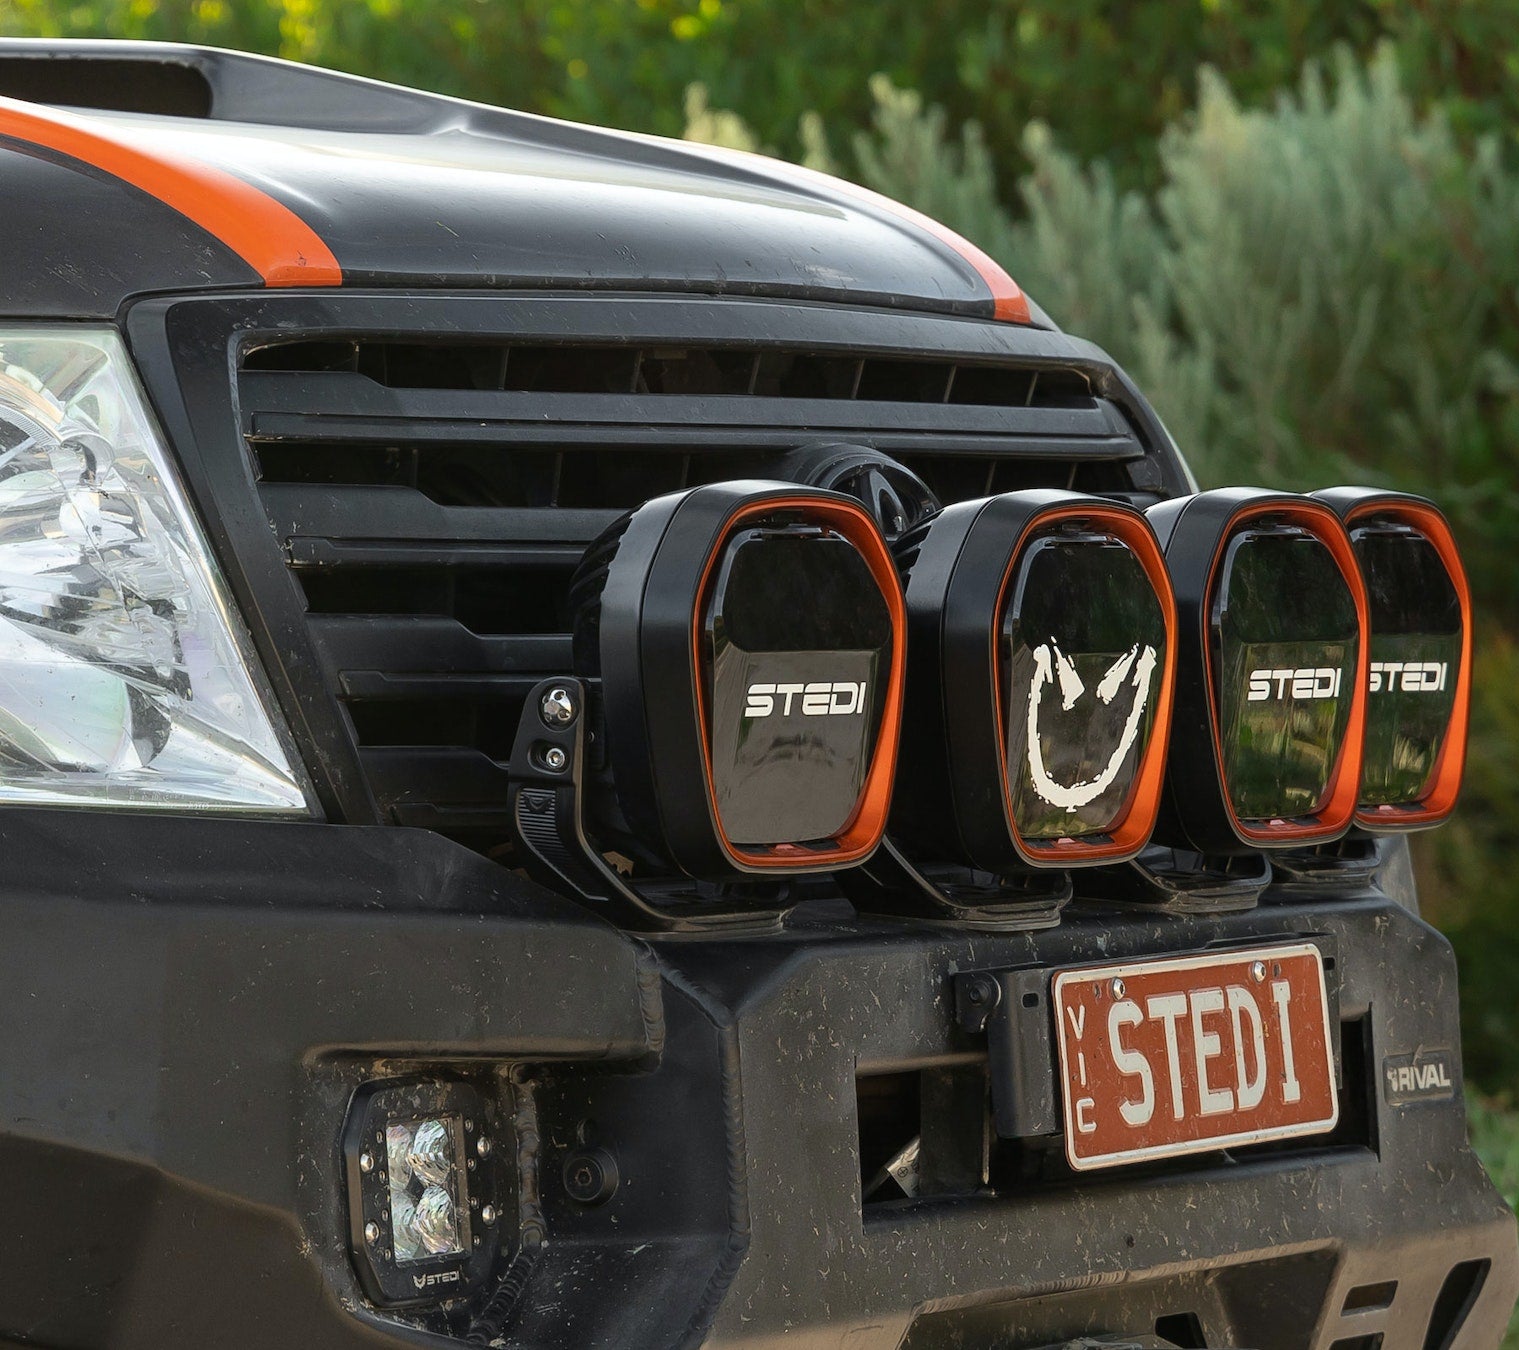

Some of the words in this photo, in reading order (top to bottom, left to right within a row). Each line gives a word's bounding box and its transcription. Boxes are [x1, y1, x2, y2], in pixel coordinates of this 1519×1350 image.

[1247, 667, 1342, 701] STEDI
[1368, 662, 1448, 692] STEDI
[744, 681, 867, 718] STEDI
[1066, 1004, 1097, 1133] VIC
[1107, 980, 1301, 1126] STEDI
[1397, 1063, 1451, 1092] RIVAL
[426, 1270, 459, 1285] STEDI
